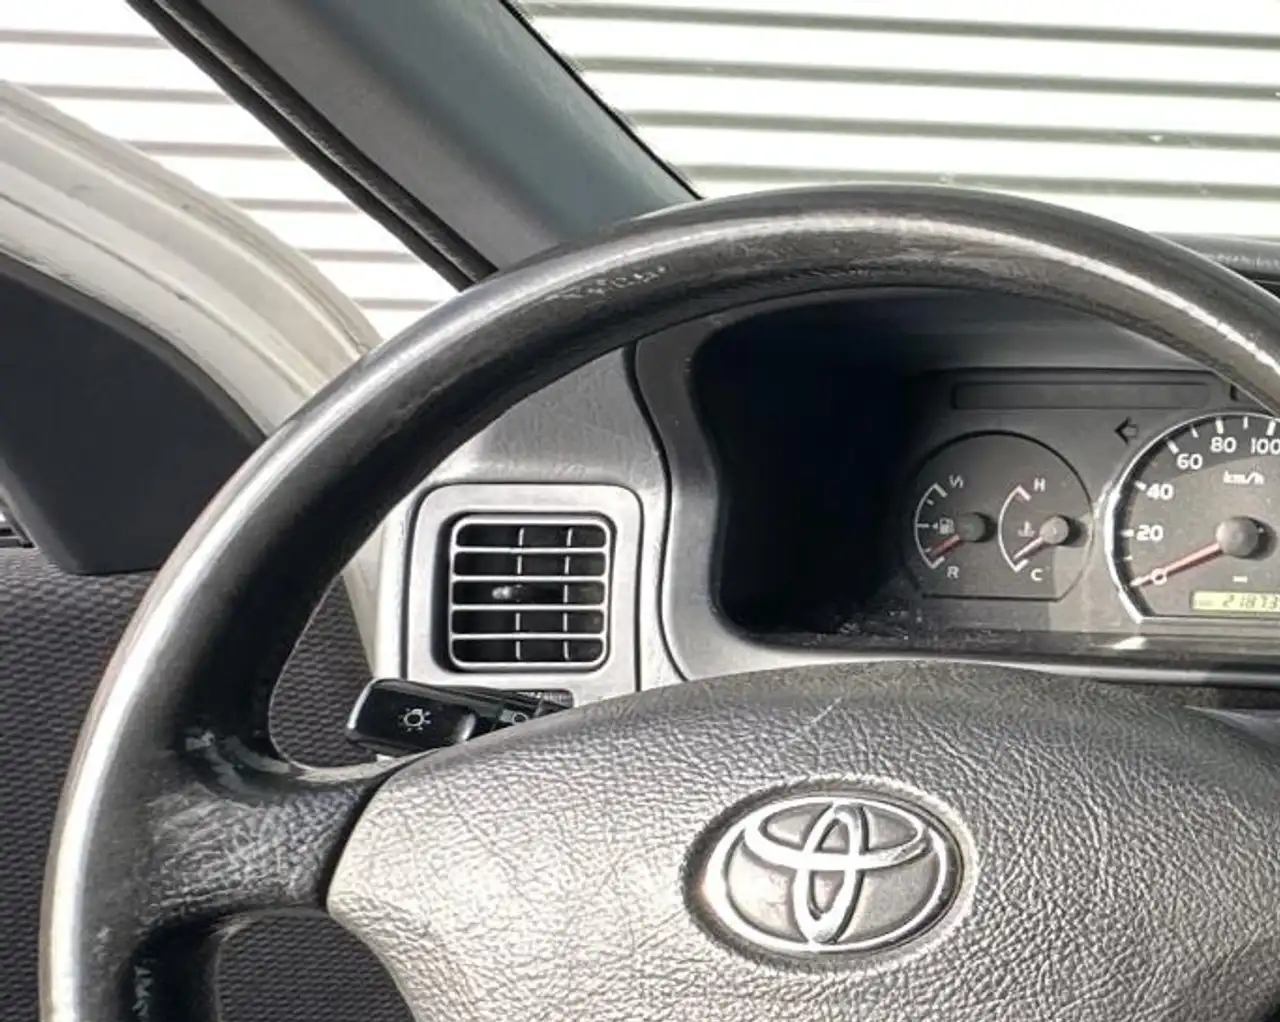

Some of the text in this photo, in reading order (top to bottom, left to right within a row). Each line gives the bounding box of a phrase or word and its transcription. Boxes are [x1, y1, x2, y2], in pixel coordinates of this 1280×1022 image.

[1210, 437, 1237, 453] 80
[1176, 453, 1203, 470] 60
[1033, 478, 1046, 492] H
[1222, 471, 1265, 485] km/h
[1146, 483, 1174, 500] 40
[1135, 530, 1164, 547] 20
[946, 565, 960, 579] R
[1030, 568, 1043, 581] C
